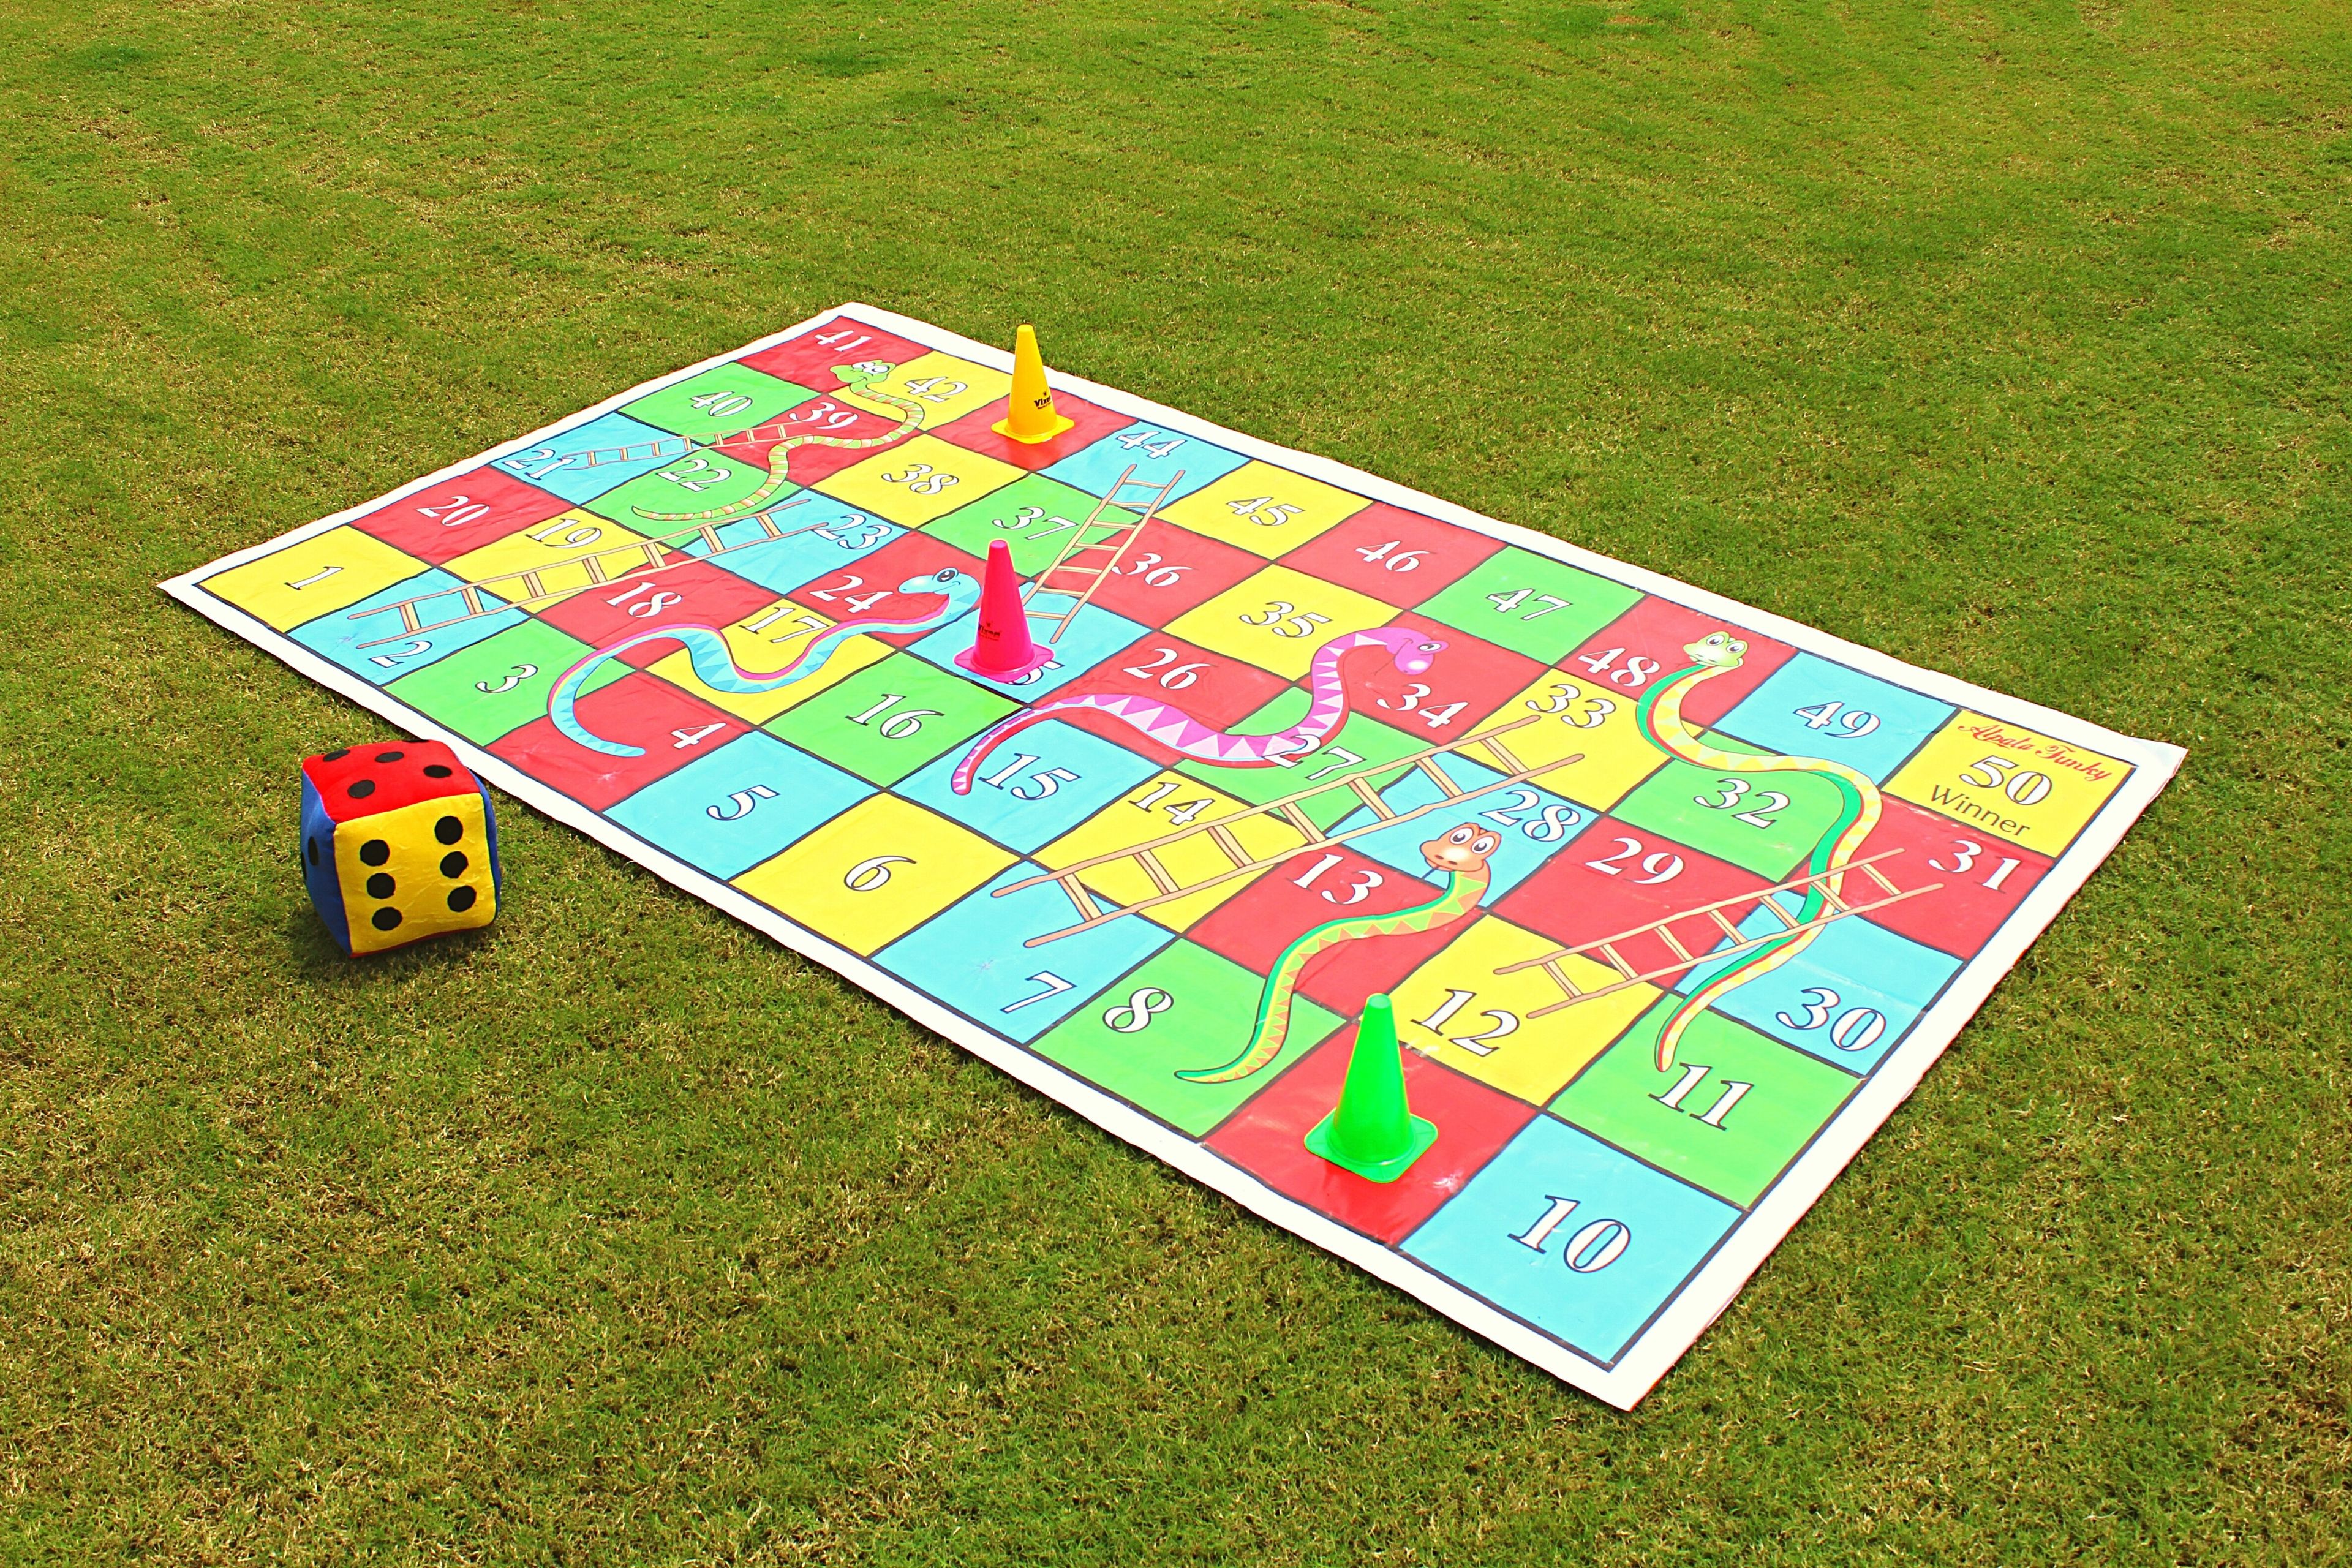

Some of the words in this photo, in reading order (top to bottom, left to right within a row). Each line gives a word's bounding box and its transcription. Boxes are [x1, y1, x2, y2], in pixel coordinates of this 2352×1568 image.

[814, 330, 872, 352] 41
[689, 391, 753, 417] 40
[905, 376, 968, 402] 42
[789, 402, 859, 429] 39
[503, 448, 576, 480] 21
[1115, 431, 1186, 459] 44
[655, 458, 732, 492] 22
[881, 464, 959, 495] 38
[415, 496, 490, 527] 20
[992, 506, 1078, 540] 37
[1226, 496, 1305, 527] 45
[525, 518, 603, 549] 19
[813, 513, 892, 550] 23
[1113, 552, 1194, 588] 36
[1354, 539, 1434, 573] 46
[284, 565, 344, 590] 1
[808, 574, 894, 613] 24
[604, 582, 682, 618] 18
[1240, 600, 1333, 638] 35
[1485, 587, 1572, 622] 47
[738, 606, 829, 644] 17
[367, 640, 434, 669] 2
[1122, 647, 1219, 690] 26
[1577, 646, 1661, 688] 48
[475, 663, 539, 693] 3
[845, 693, 944, 740] 16
[1376, 683, 1469, 729] 34
[1525, 683, 1616, 729] 33
[1792, 700, 1882, 739] 49
[670, 722, 728, 750] 4
[1262, 733, 1366, 781] 27
[2035, 744, 2114, 782] Funky
[978, 752, 1082, 802] 15
[1959, 755, 2053, 805] 50
[705, 783, 781, 821] 5
[1128, 781, 1216, 826] 14
[1477, 788, 1581, 843] 28
[1694, 777, 1792, 830] 32
[1931, 784, 2030, 837] Winner
[843, 855, 917, 892] 6
[1286, 852, 1385, 905] 13
[1583, 836, 1686, 886] 29
[1928, 839, 2024, 894] 31
[1000, 970, 1077, 1014] 7
[1102, 987, 1174, 1033] 8
[1410, 987, 1521, 1058] 12
[1774, 986, 1887, 1053] 30
[1646, 1061, 1755, 1132] 11
[1506, 1194, 1632, 1274] 10
